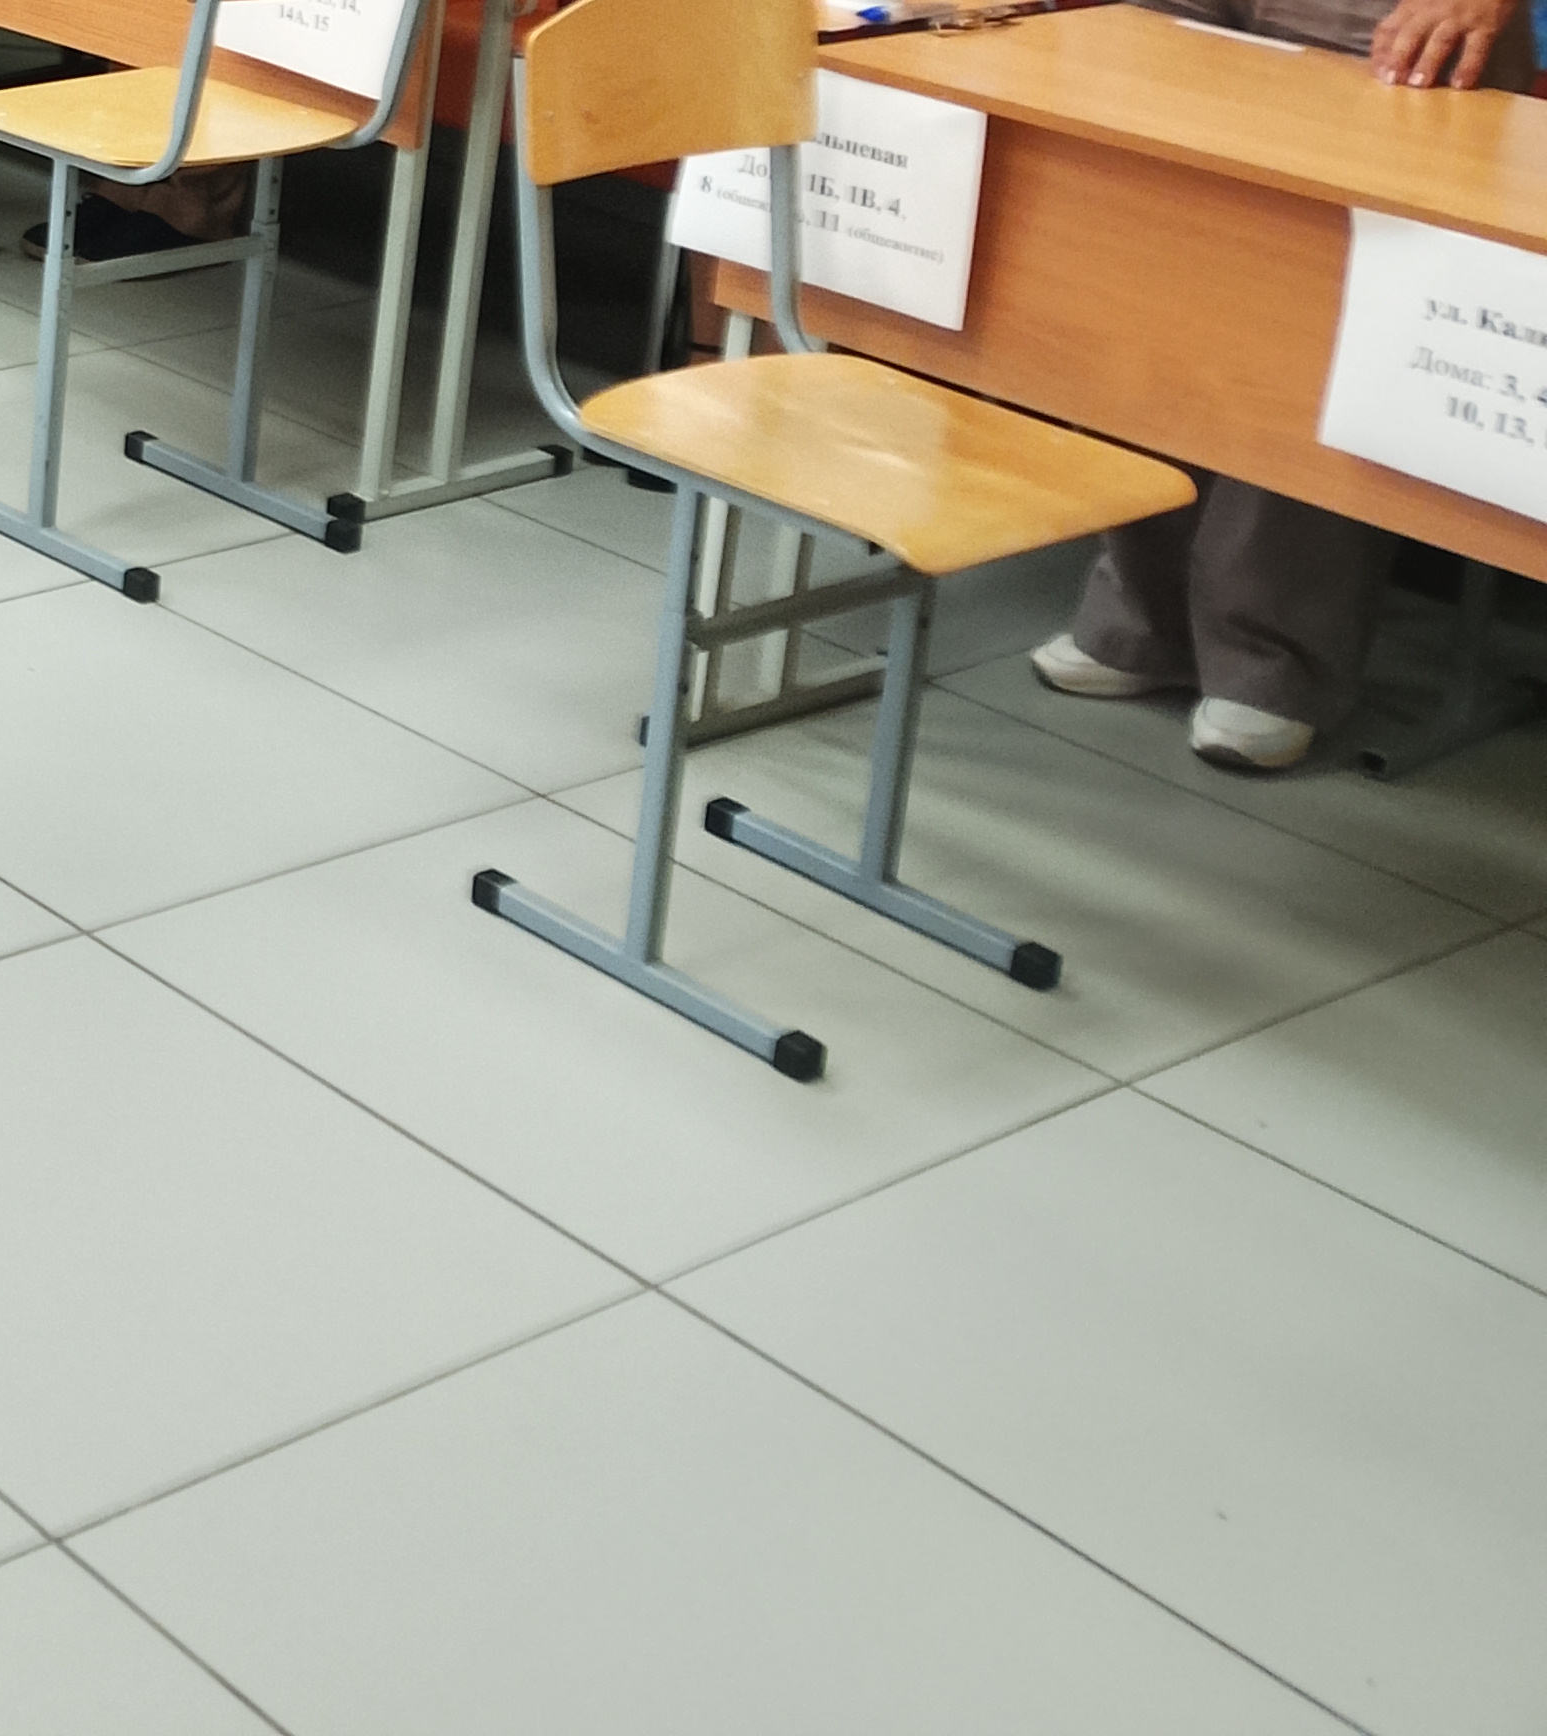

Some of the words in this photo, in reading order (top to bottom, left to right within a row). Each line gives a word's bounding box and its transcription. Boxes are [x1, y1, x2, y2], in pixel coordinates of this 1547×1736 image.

[313, 14, 330, 32] 15
[810, 132, 909, 170] льцевая
[700, 175, 713, 194] 8
[807, 173, 841, 201] 1Б,
[848, 185, 882, 213] 1В,
[1425, 298, 1467, 325] ул.
[1411, 345, 1492, 390] Дома:
[1499, 373, 1526, 402] 3,
[1448, 395, 1485, 430] 10,
